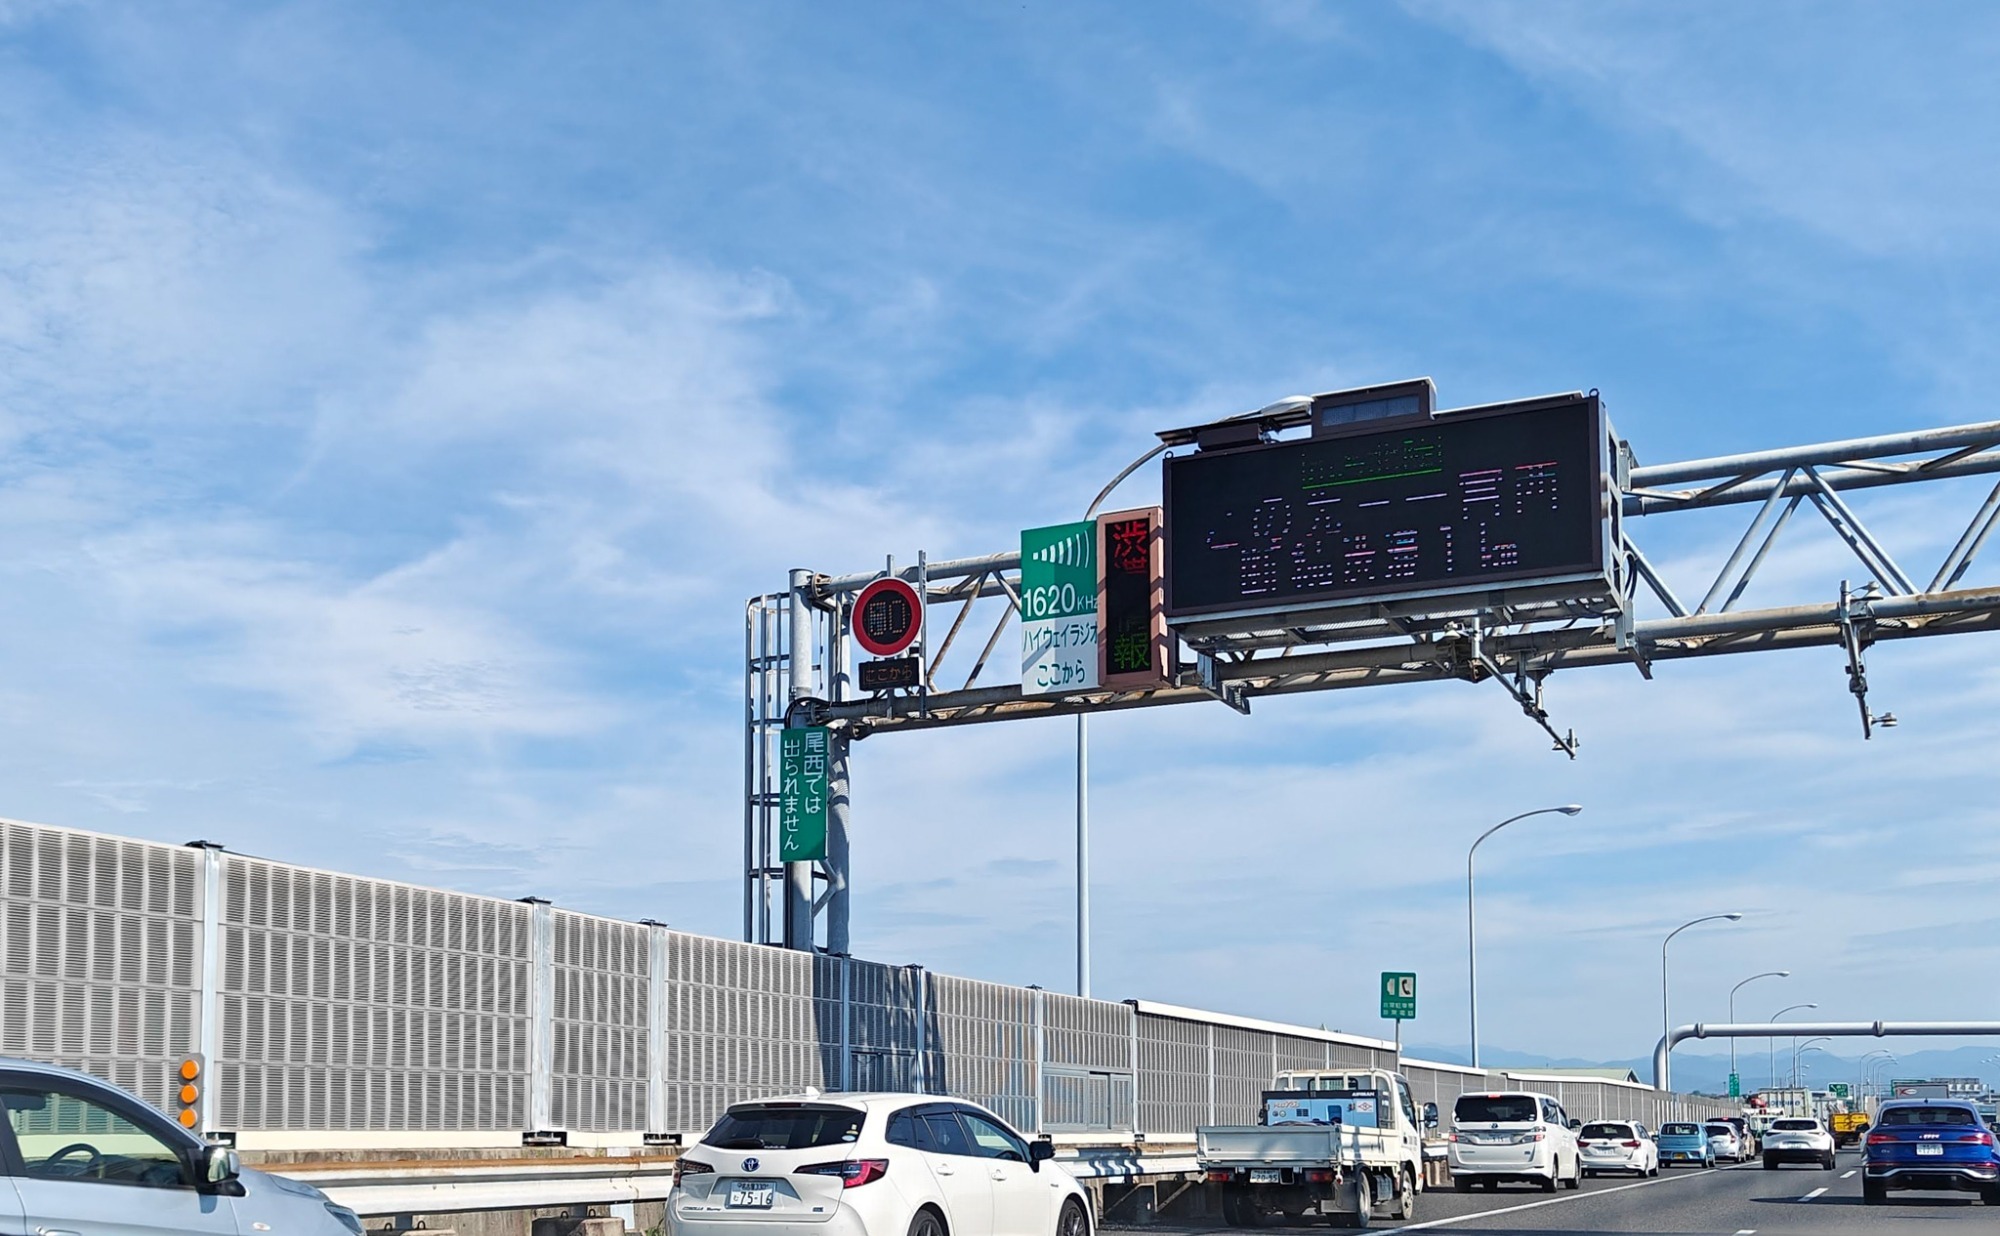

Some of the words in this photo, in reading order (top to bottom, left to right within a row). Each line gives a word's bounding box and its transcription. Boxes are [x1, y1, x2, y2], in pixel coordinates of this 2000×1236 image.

[1023, 582, 1076, 617] 1620
[1023, 621, 1098, 652] ハイウェイラジオ
[1037, 659, 1086, 687] ここから
[803, 731, 825, 815] 尾西では
[783, 738, 801, 851] 出られません
[740, 1191, 773, 1206] 75-16
